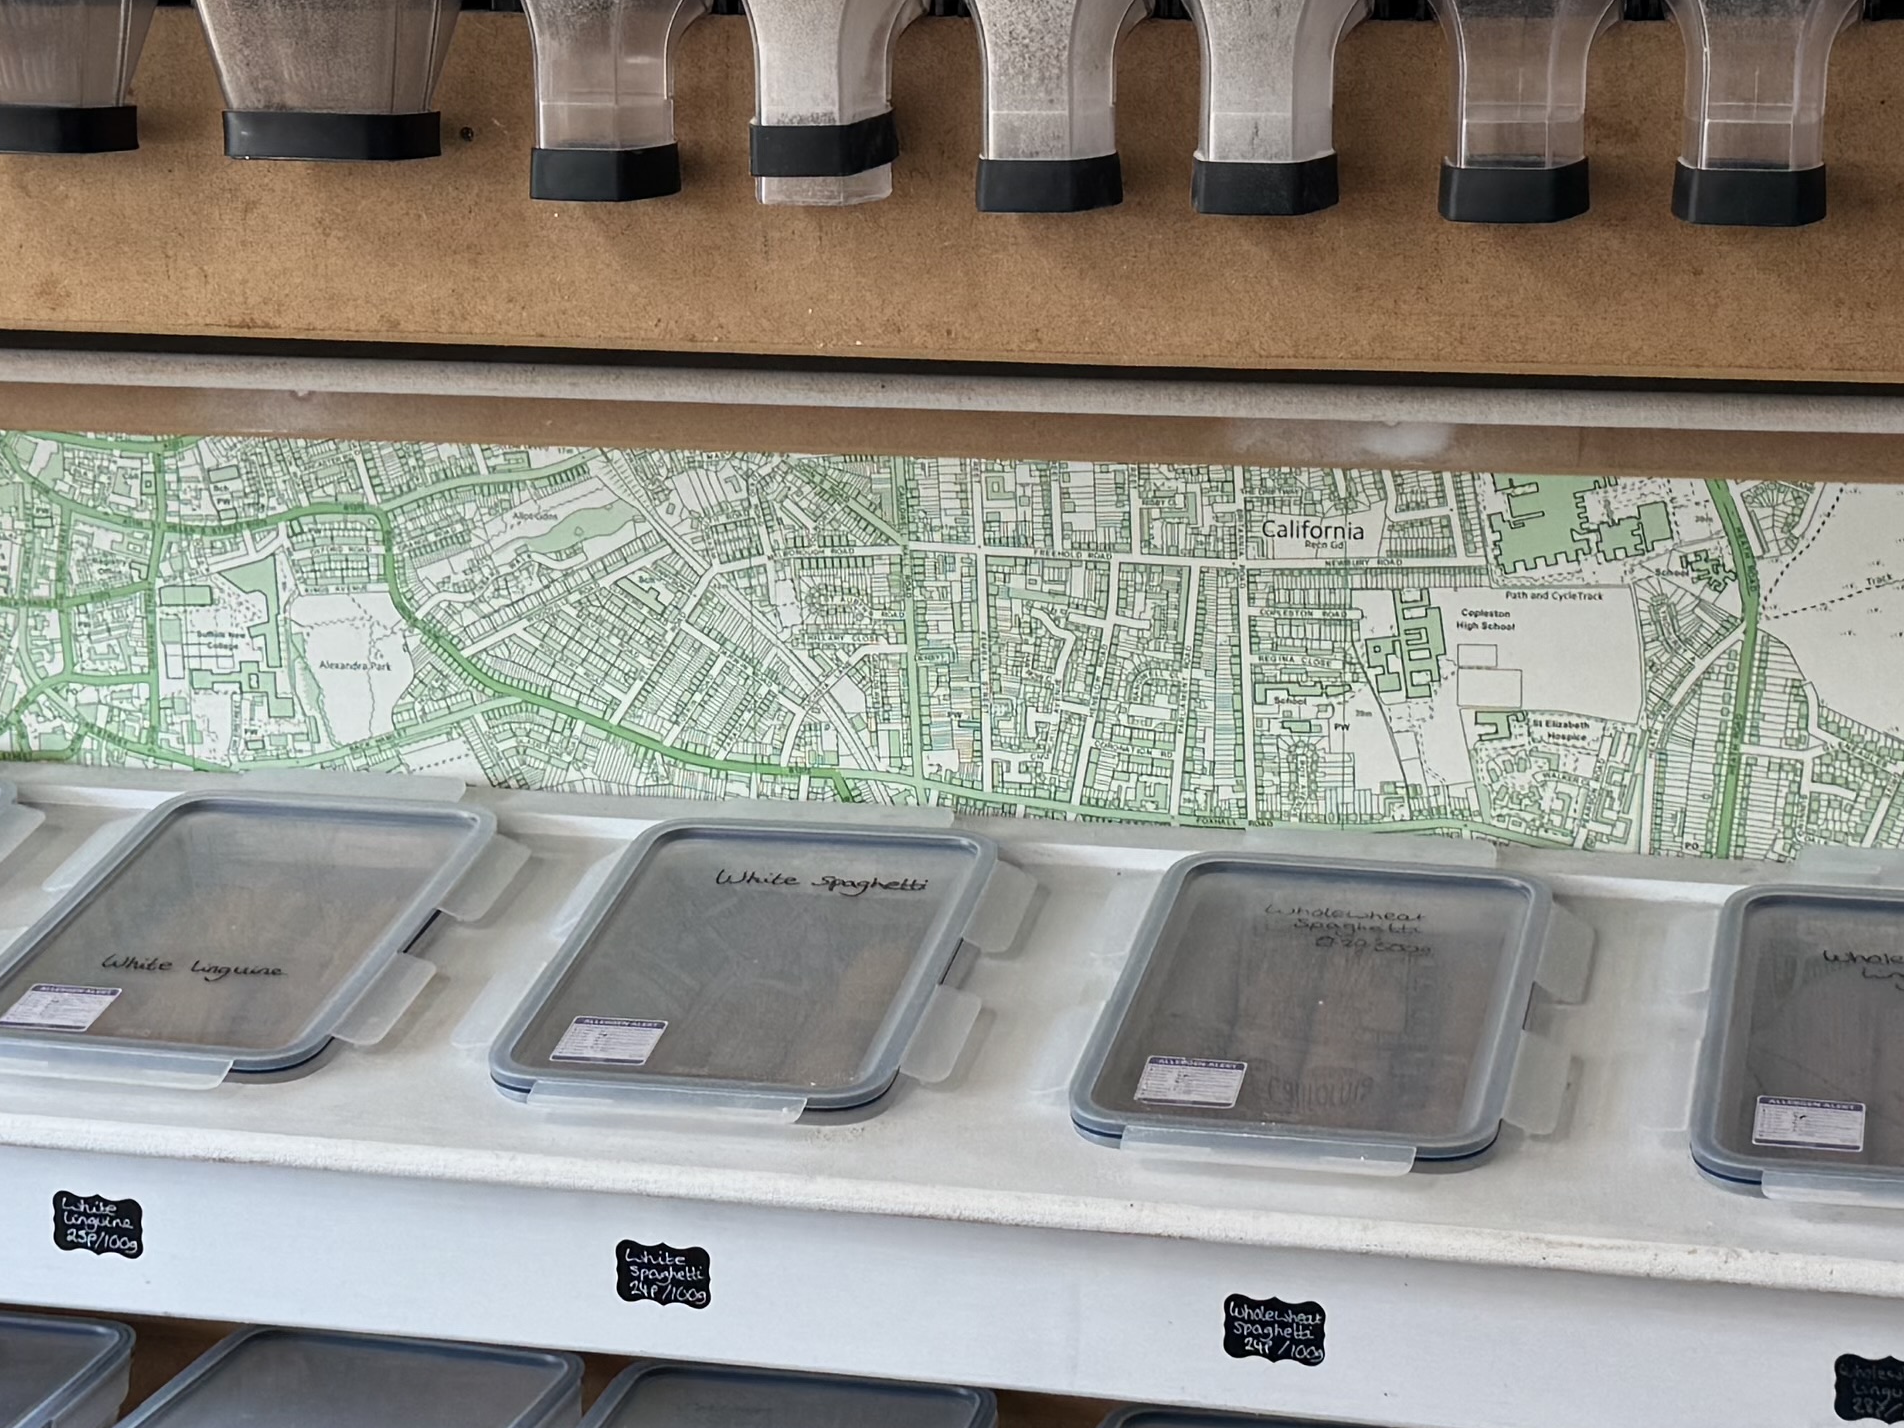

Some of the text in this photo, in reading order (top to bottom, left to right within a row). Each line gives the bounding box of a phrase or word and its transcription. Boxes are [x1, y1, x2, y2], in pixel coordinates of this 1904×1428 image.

[1262, 519, 1365, 541] California
[1866, 573, 1894, 587] Track
[1505, 590, 1549, 601] Path and
[1460, 608, 1511, 619] Copleston
[1456, 621, 1516, 632] High School
[318, 659, 393, 673] Alexandra Park
[1545, 719, 1590, 730] Elizabeth
[1547, 732, 1587, 742] Hospice
[715, 868, 800, 887] White
[101, 953, 174, 972] White
[61, 1196, 117, 1216] White
[625, 1248, 686, 1265] White
[1229, 1301, 1322, 1325] Wholewheat
